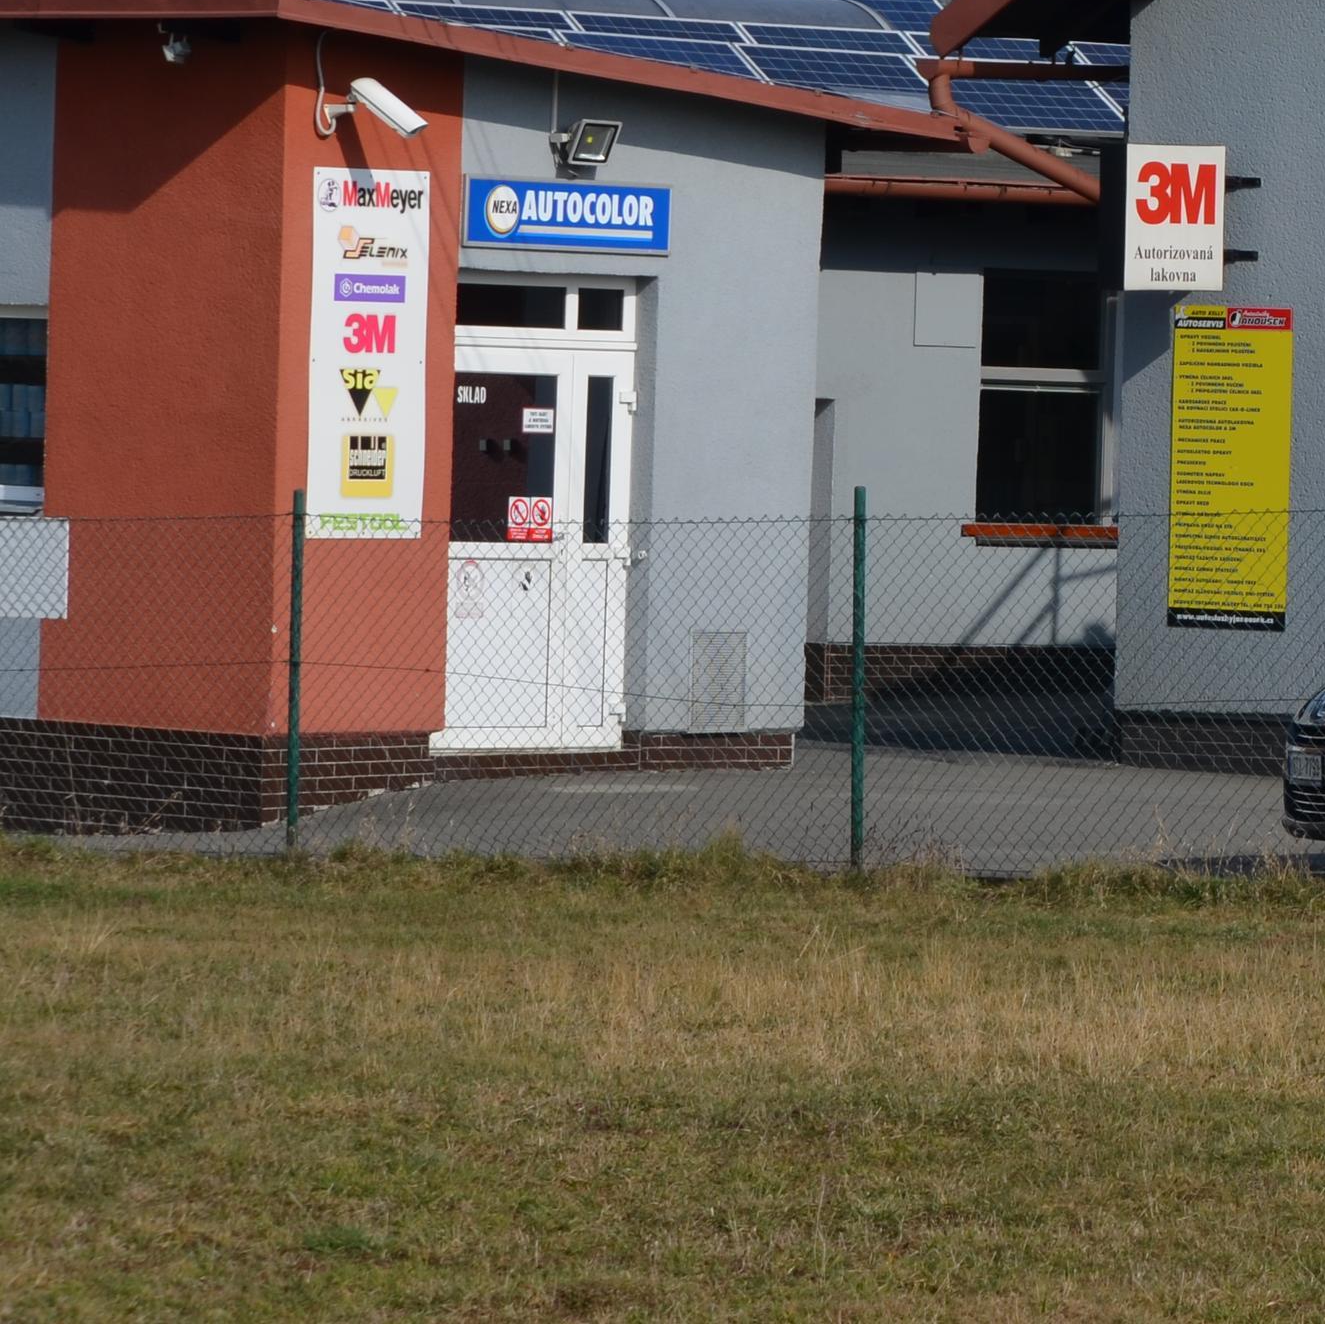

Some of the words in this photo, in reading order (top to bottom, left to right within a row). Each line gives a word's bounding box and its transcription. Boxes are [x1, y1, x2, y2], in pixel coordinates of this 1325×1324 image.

[343, 180, 423, 214] MaxMeyer
[1135, 161, 1217, 225] 3M
[492, 200, 517, 214] NEXA
[521, 190, 654, 226] AUTOCOLOR
[1134, 245, 1214, 260] Autorizovaná
[1150, 267, 1197, 283] lakovna
[353, 282, 400, 295] Chemolak
[343, 313, 396, 353] 3M
[1177, 319, 1224, 328] AUTOSERVIS
[342, 368, 379, 389] sia
[457, 385, 487, 404] SKLAD
